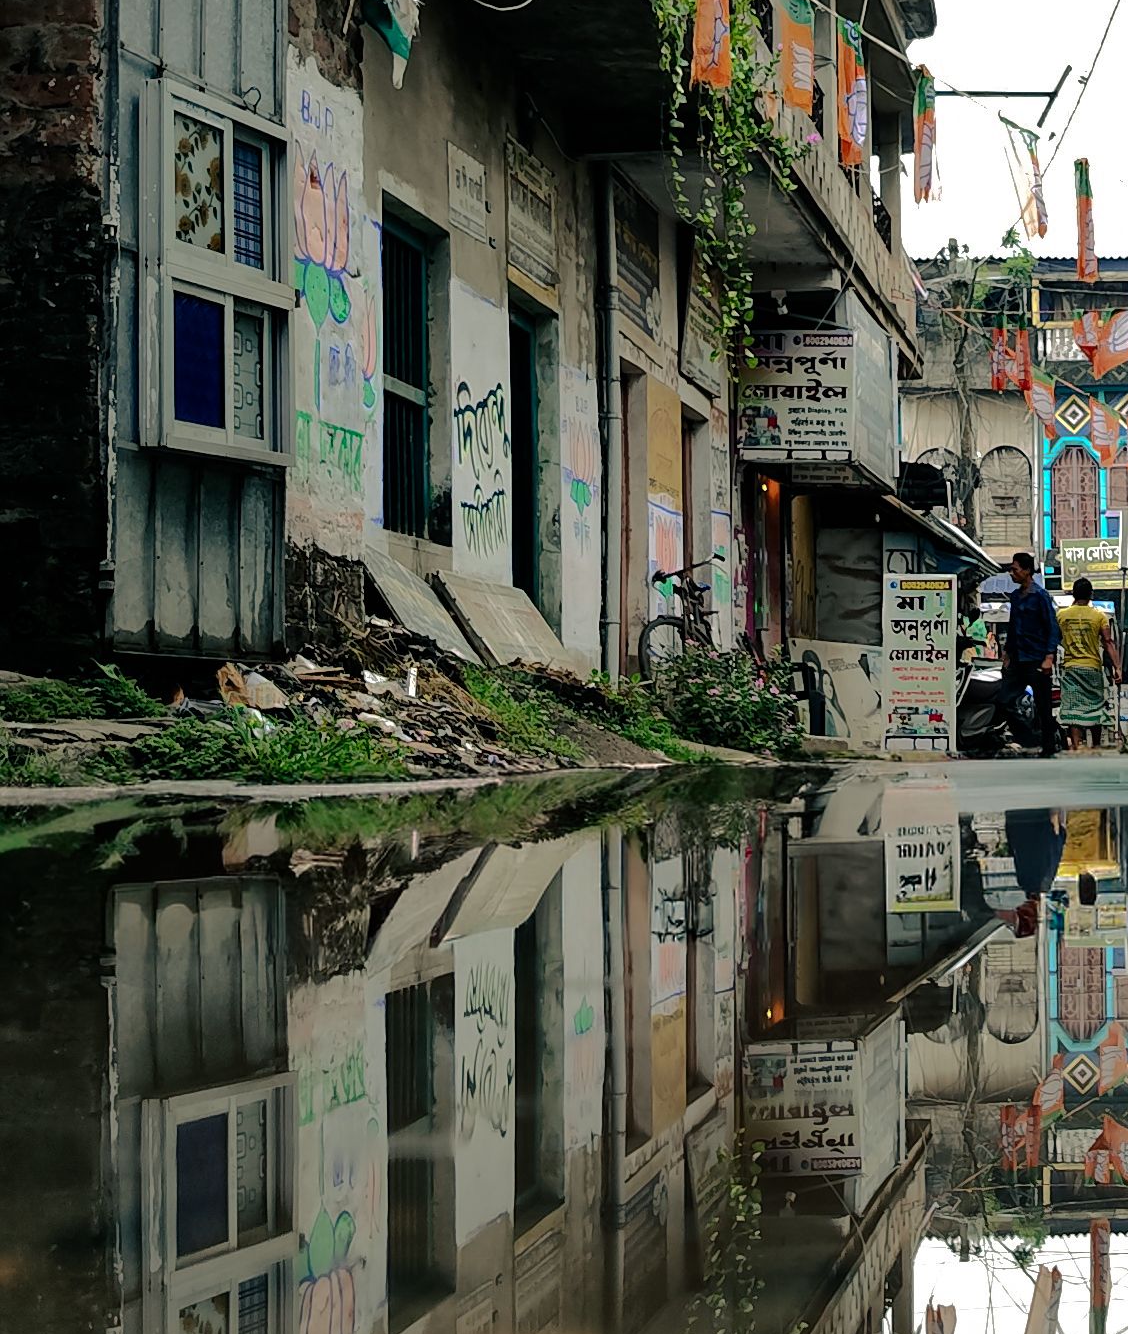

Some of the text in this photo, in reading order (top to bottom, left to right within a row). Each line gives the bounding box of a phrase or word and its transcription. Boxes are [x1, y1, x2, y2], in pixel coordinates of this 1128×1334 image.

[741, 379, 848, 402] মোবাইল
[1064, 547, 1085, 563] দাস
[895, 595, 927, 611] মা
[890, 611, 949, 643] অন্নপূর্ণা
[889, 643, 949, 664] মোবাইল
